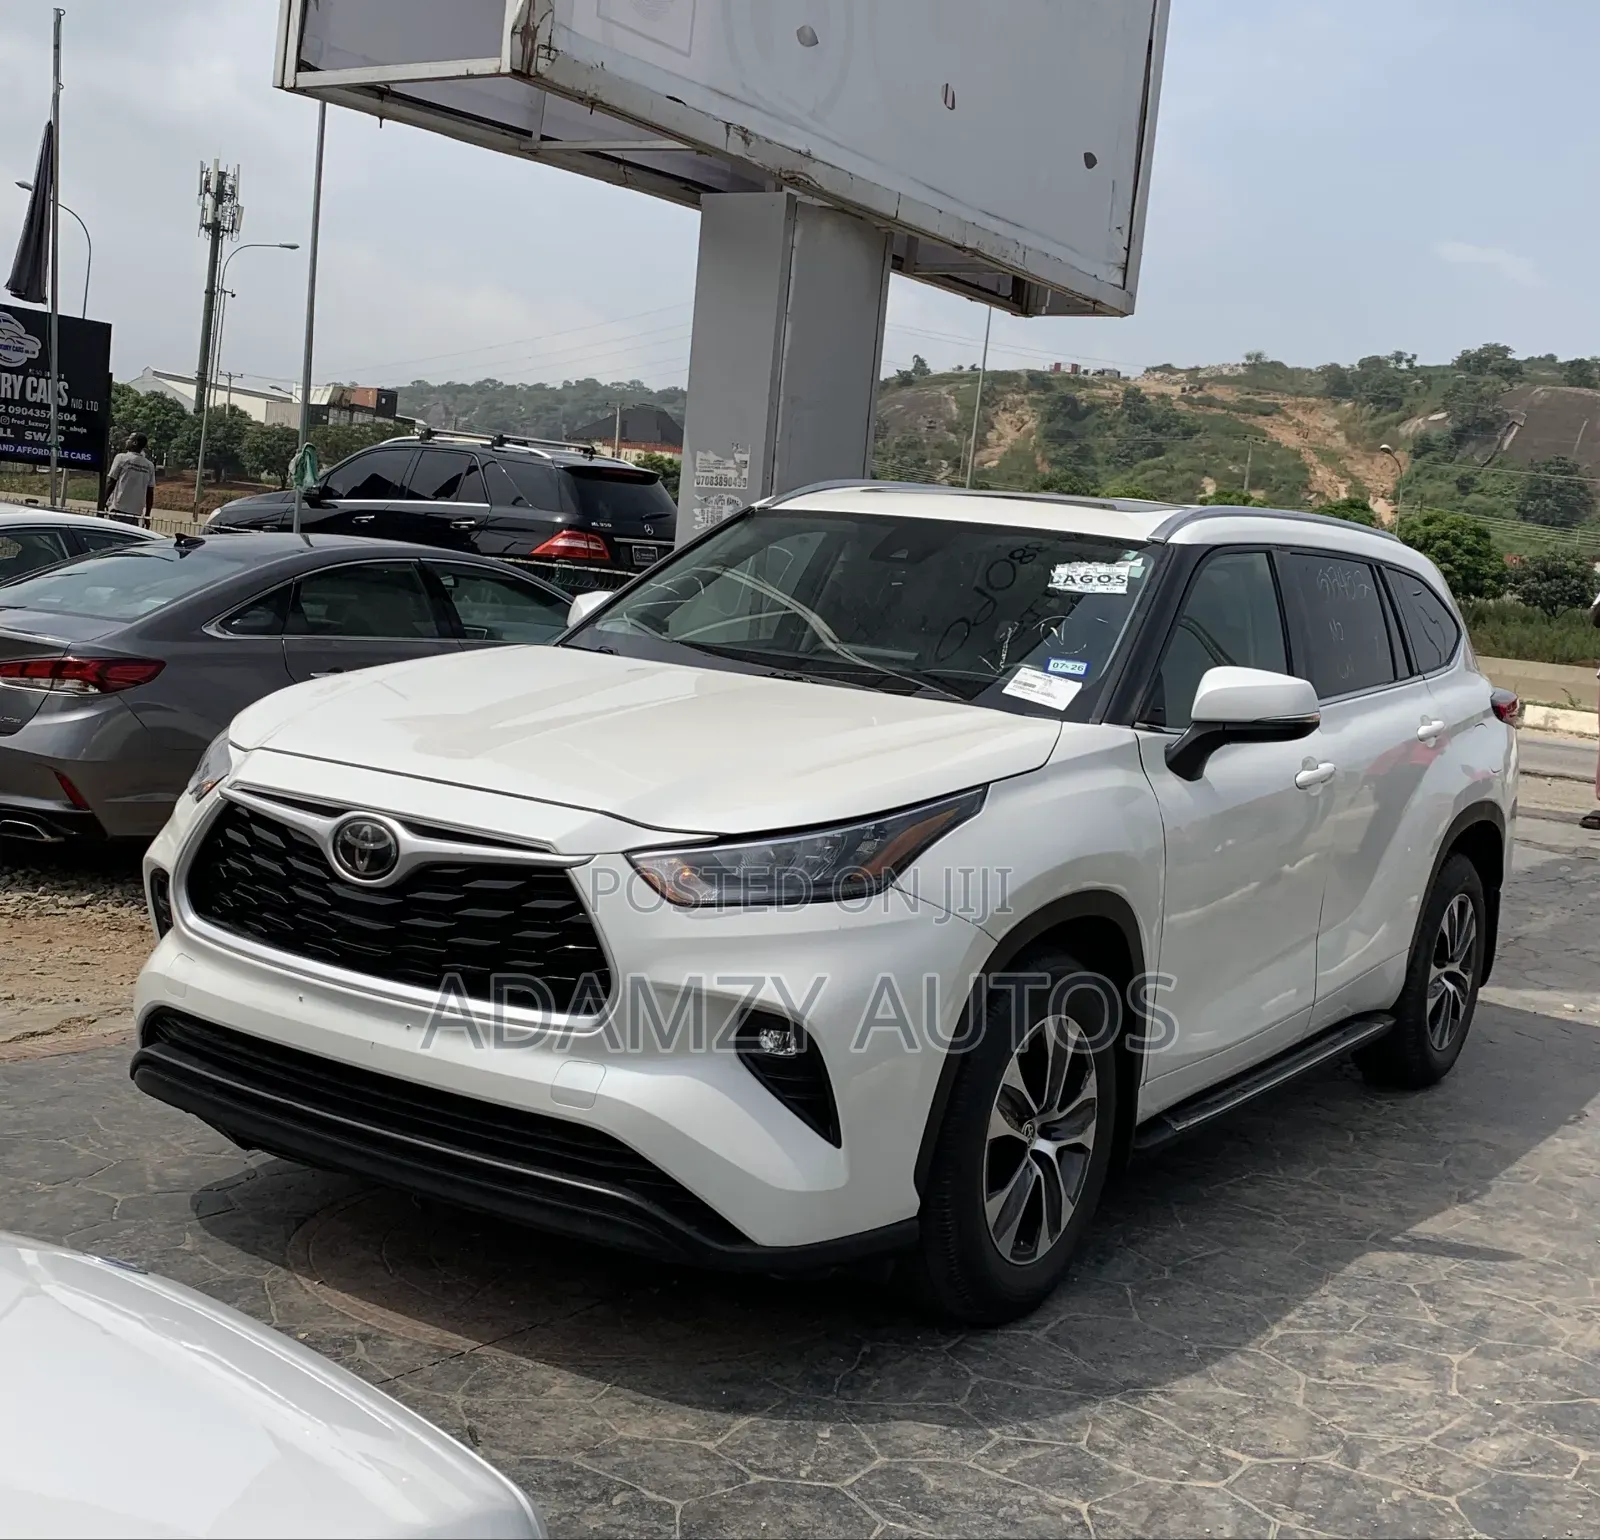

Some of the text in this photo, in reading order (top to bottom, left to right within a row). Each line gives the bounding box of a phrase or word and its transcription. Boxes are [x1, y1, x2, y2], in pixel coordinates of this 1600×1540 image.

[26, 376, 69, 407] CAS
[8, 405, 77, 421] 0904357504
[16, 446, 69, 458] AFFORDLE
[70, 452, 92, 461] CARS
[1050, 574, 1127, 585] LAGOS
